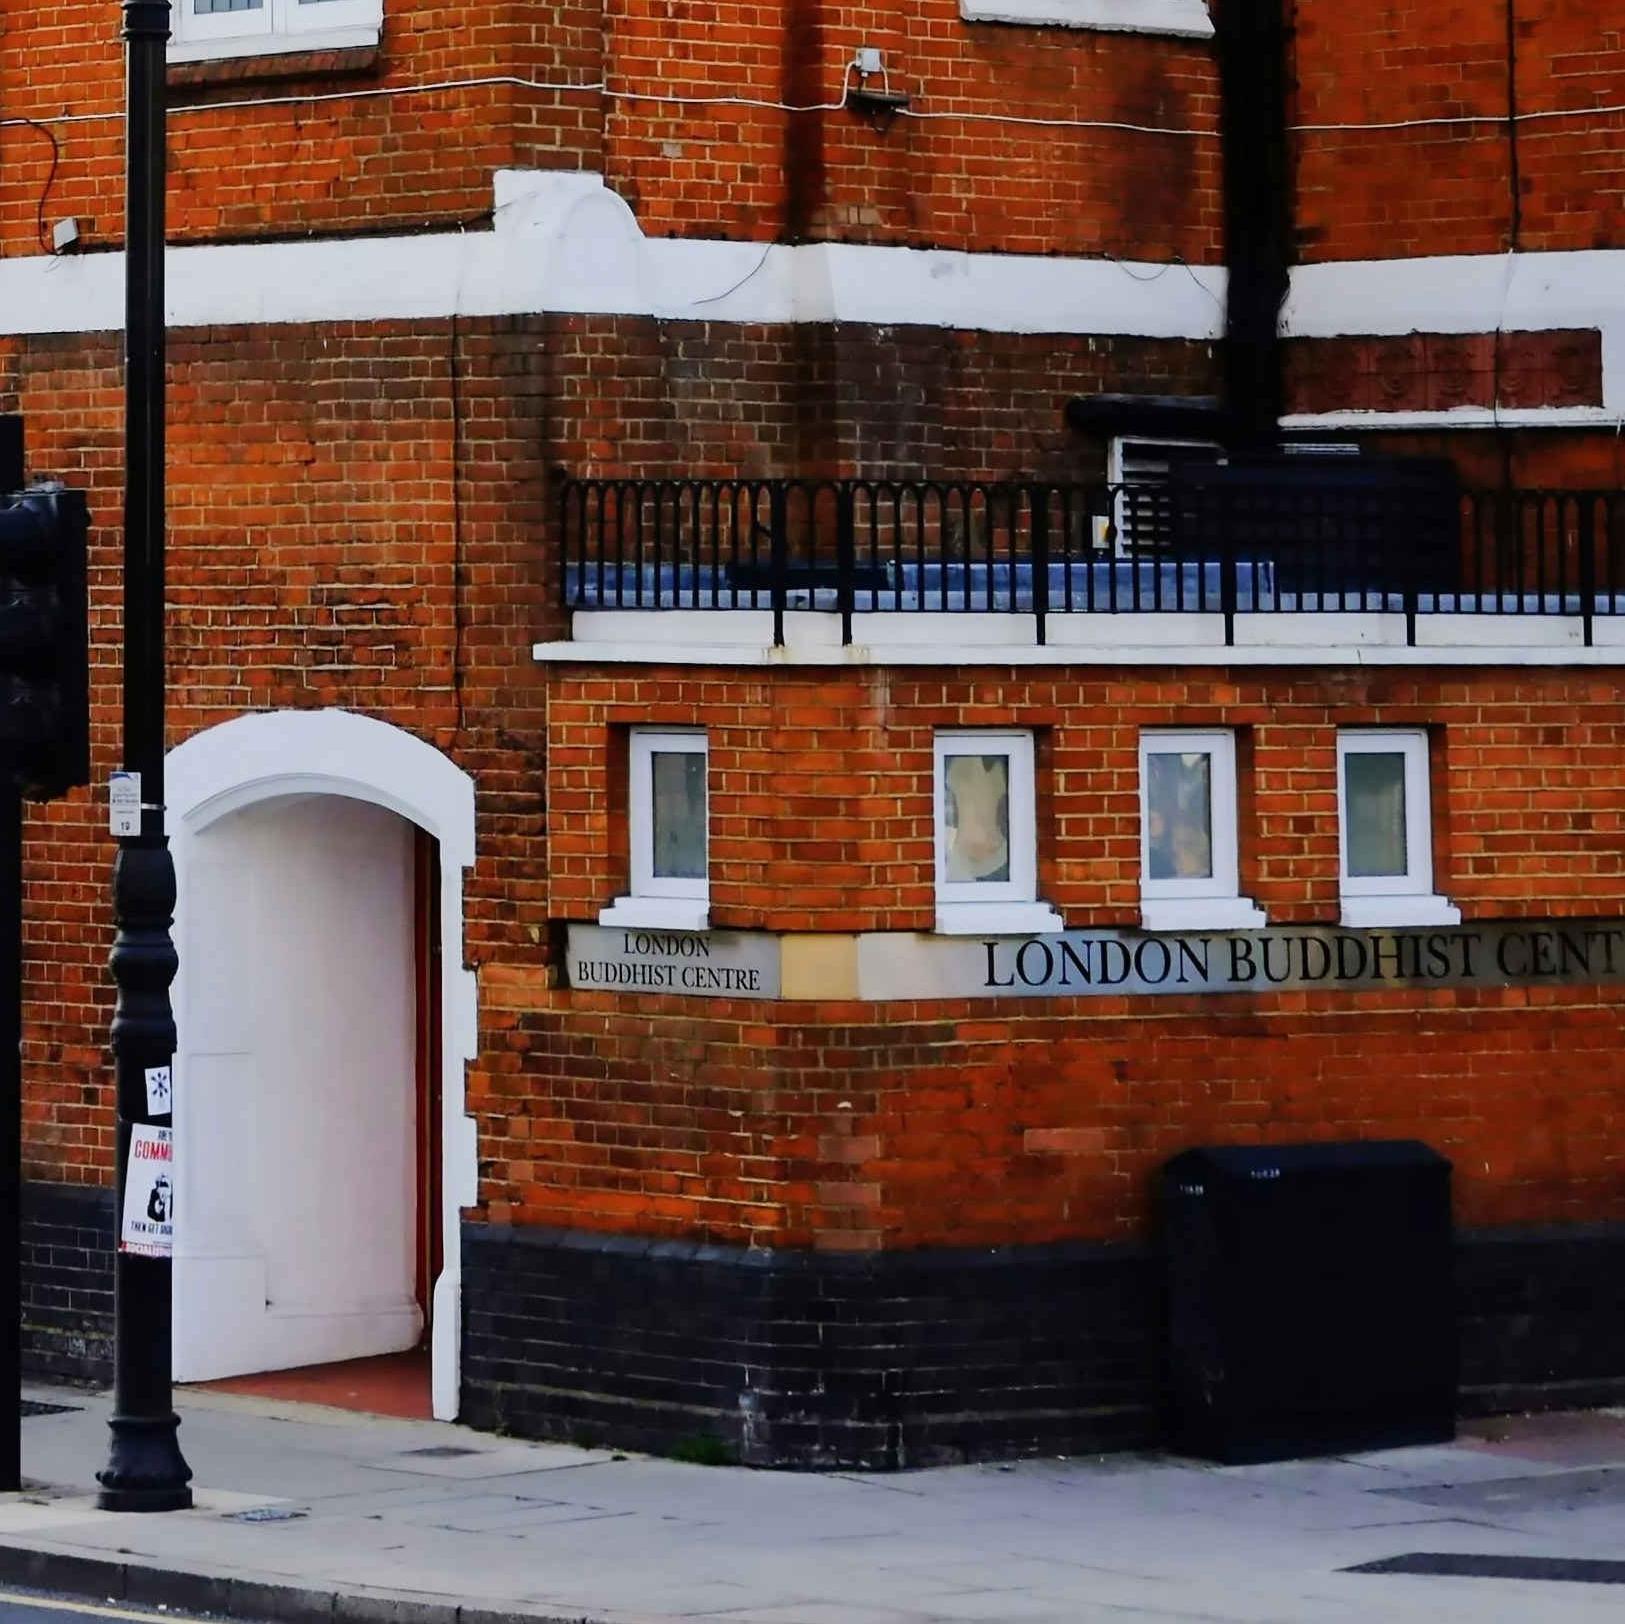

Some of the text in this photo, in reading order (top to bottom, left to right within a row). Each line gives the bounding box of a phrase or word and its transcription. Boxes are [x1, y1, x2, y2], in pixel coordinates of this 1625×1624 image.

[623, 933, 711, 957] LONDON
[982, 930, 1624, 987] LONDON BUDDHIST CENT
[577, 960, 761, 991] BUDDHIST CENTRE
